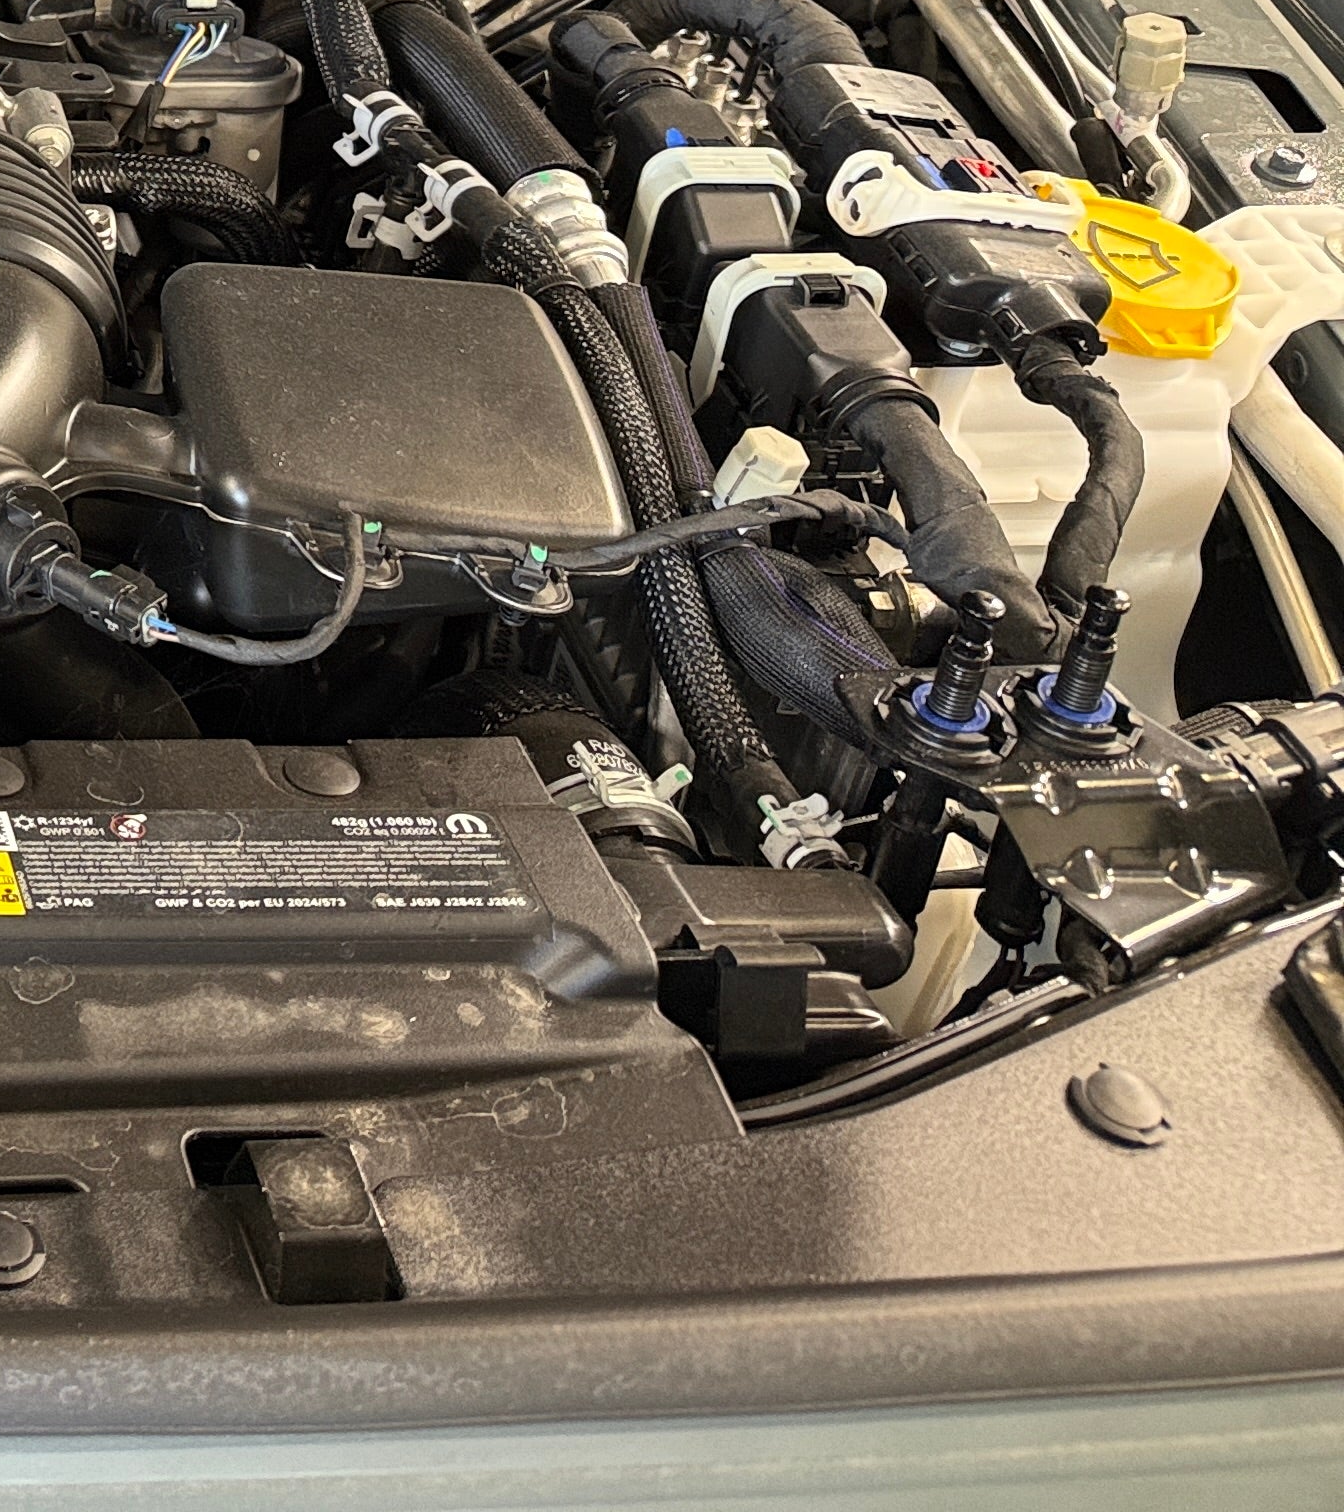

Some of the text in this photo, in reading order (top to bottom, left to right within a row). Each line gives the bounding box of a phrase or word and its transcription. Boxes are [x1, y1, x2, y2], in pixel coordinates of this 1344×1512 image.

[588, 739, 626, 758] RAD
[39, 827, 71, 836] GWP
[343, 827, 372, 836] CO2
[63, 897, 94, 908] PAG
[154, 897, 189, 908] GWP
[192, 898, 204, 908] &
[205, 898, 237, 908] CO2
[238, 898, 261, 909] per
[263, 897, 284, 908] EU
[375, 897, 407, 908] SAE
